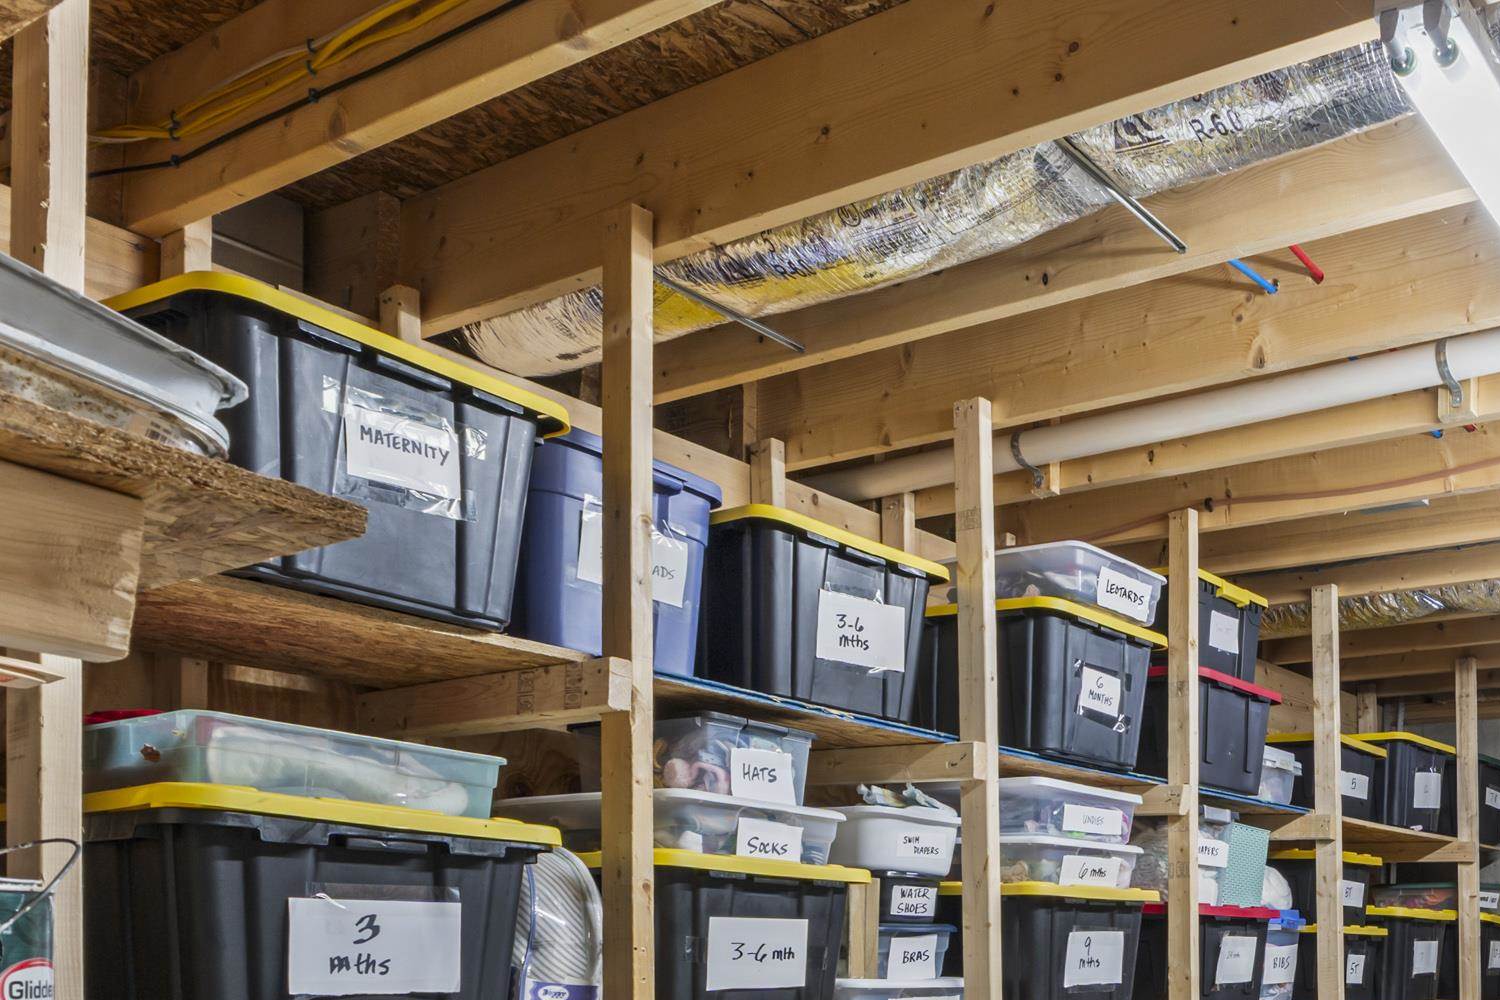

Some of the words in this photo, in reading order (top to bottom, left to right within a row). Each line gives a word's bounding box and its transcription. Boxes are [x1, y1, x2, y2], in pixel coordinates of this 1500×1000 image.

[360, 425, 450, 466] MATERNITY
[652, 565, 676, 580] ADS
[1106, 580, 1144, 606] LEOTARDS
[836, 614, 864, 632] 3-6
[839, 634, 869, 651] mths
[1096, 676, 1104, 689] 6
[1088, 689, 1113, 706] MONTHS
[743, 763, 777, 783] HATS
[903, 836, 920, 844] SWIM
[913, 846, 939, 855] DIAPERS
[1198, 846, 1219, 856] IAPERS
[1078, 862, 1088, 880] 6
[900, 888, 930, 899] WATER
[897, 902, 928, 914] SHOES
[353, 914, 380, 944] 3
[730, 942, 767, 963] 3-6
[771, 946, 795, 961] mth
[1084, 936, 1092, 956] 9
[329, 953, 391, 975] mths
[902, 949, 930, 964] BRAS
[1078, 957, 1101, 969] mths
[1273, 956, 1290, 969] BIBS
[9, 980, 53, 1000] Glidde
